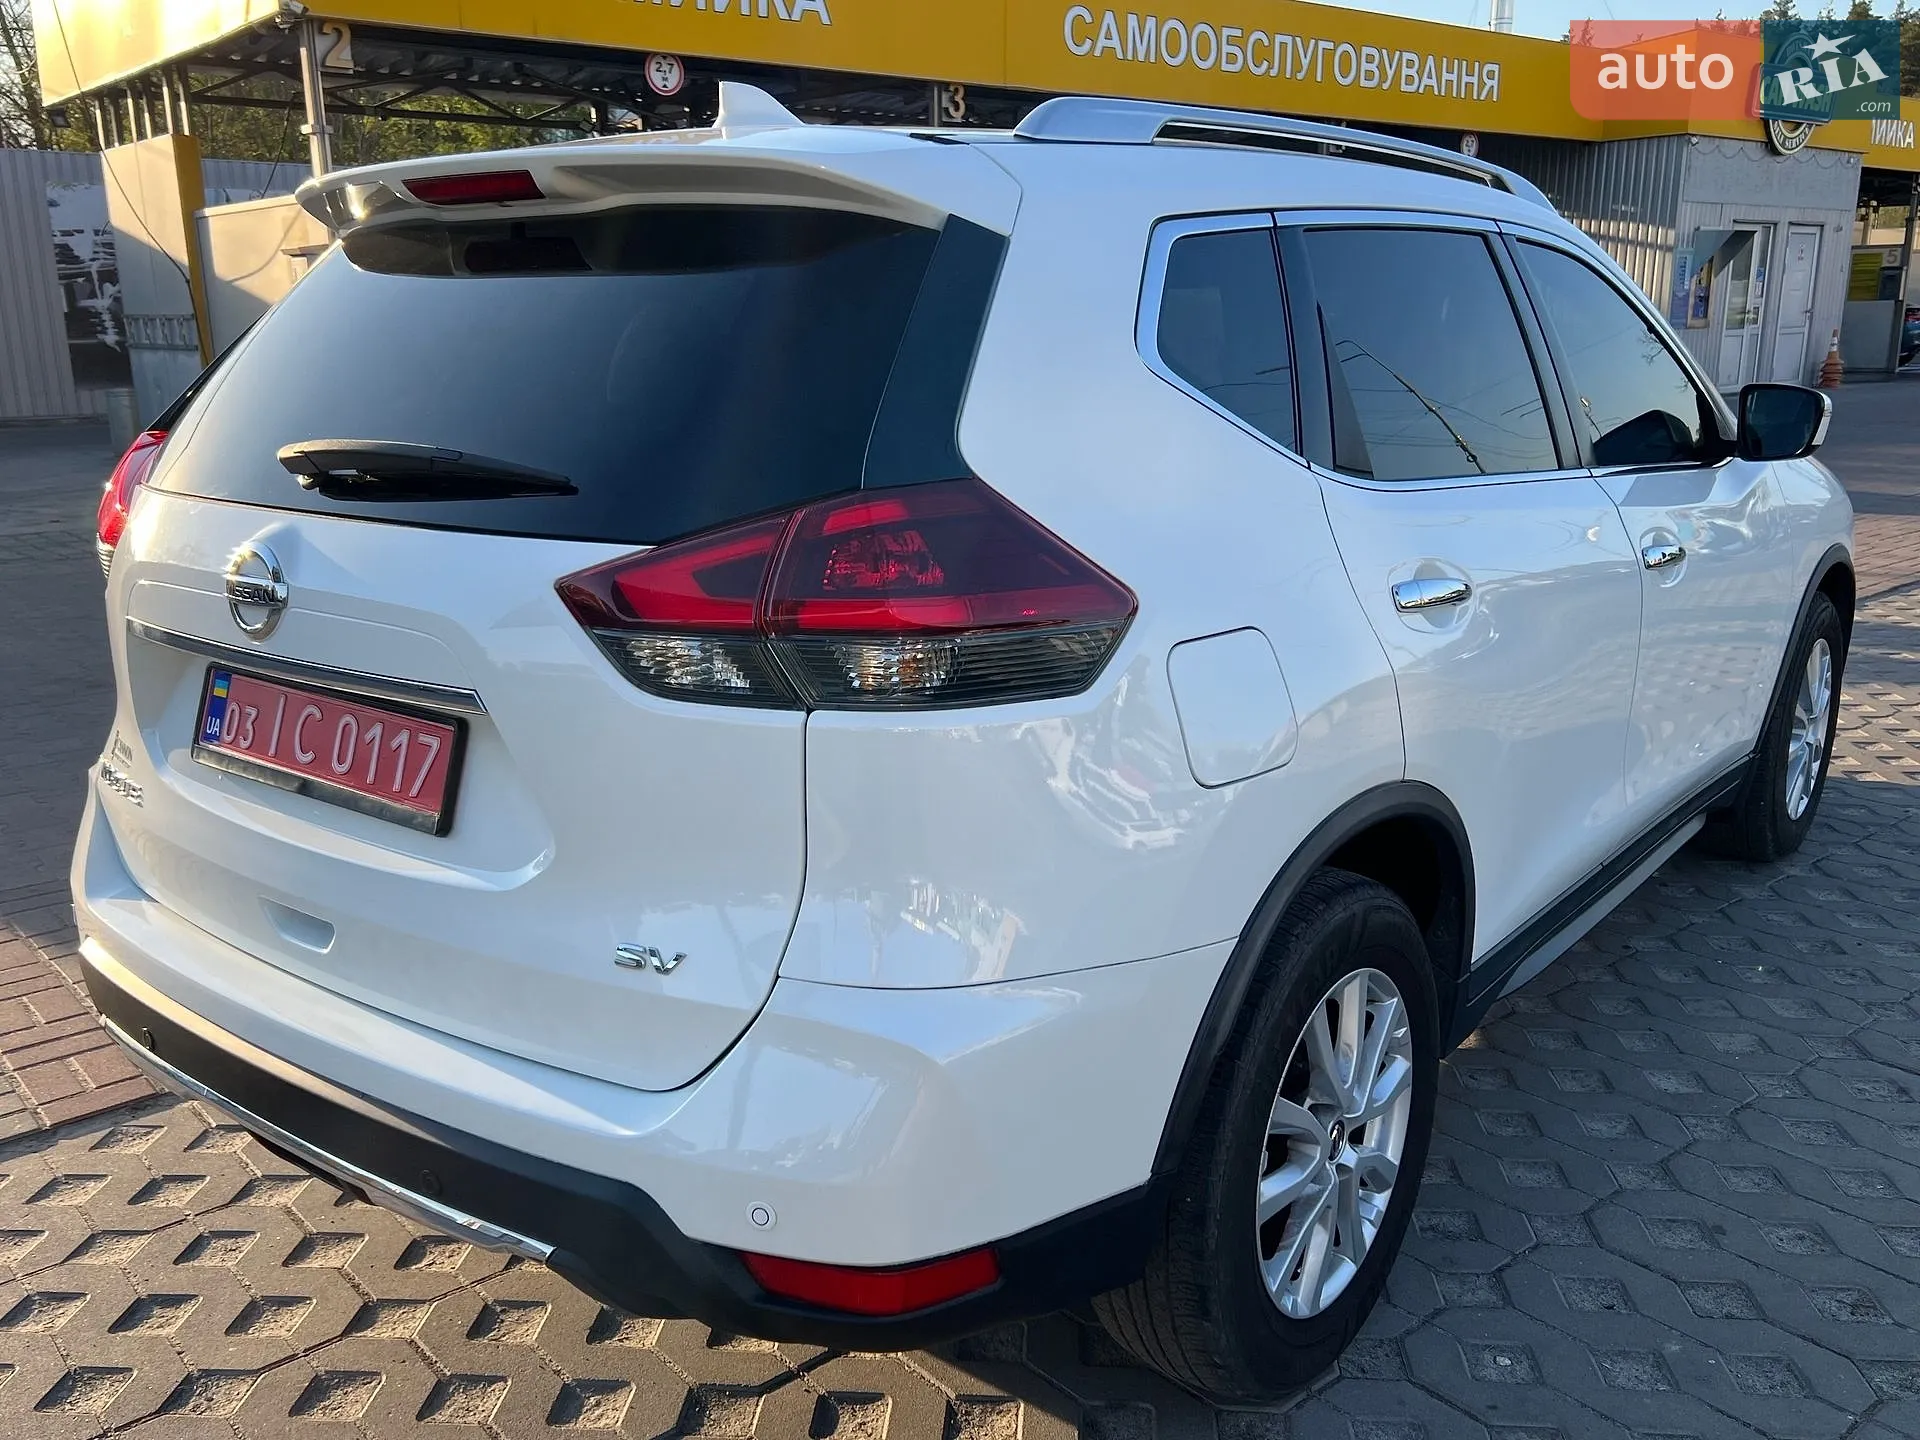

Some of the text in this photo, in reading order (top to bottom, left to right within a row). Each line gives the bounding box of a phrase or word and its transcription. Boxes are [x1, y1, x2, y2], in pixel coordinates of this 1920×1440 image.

[322, 20, 354, 68] 2
[1063, 5, 1500, 102] САМООБСЛУГОВУВАННЯ
[949, 84, 966, 118] 3
[1886, 249, 1898, 265] 5
[206, 715, 220, 737] UA
[222, 701, 260, 750] 03
[331, 712, 442, 799] 0117
[614, 942, 688, 976] SV
